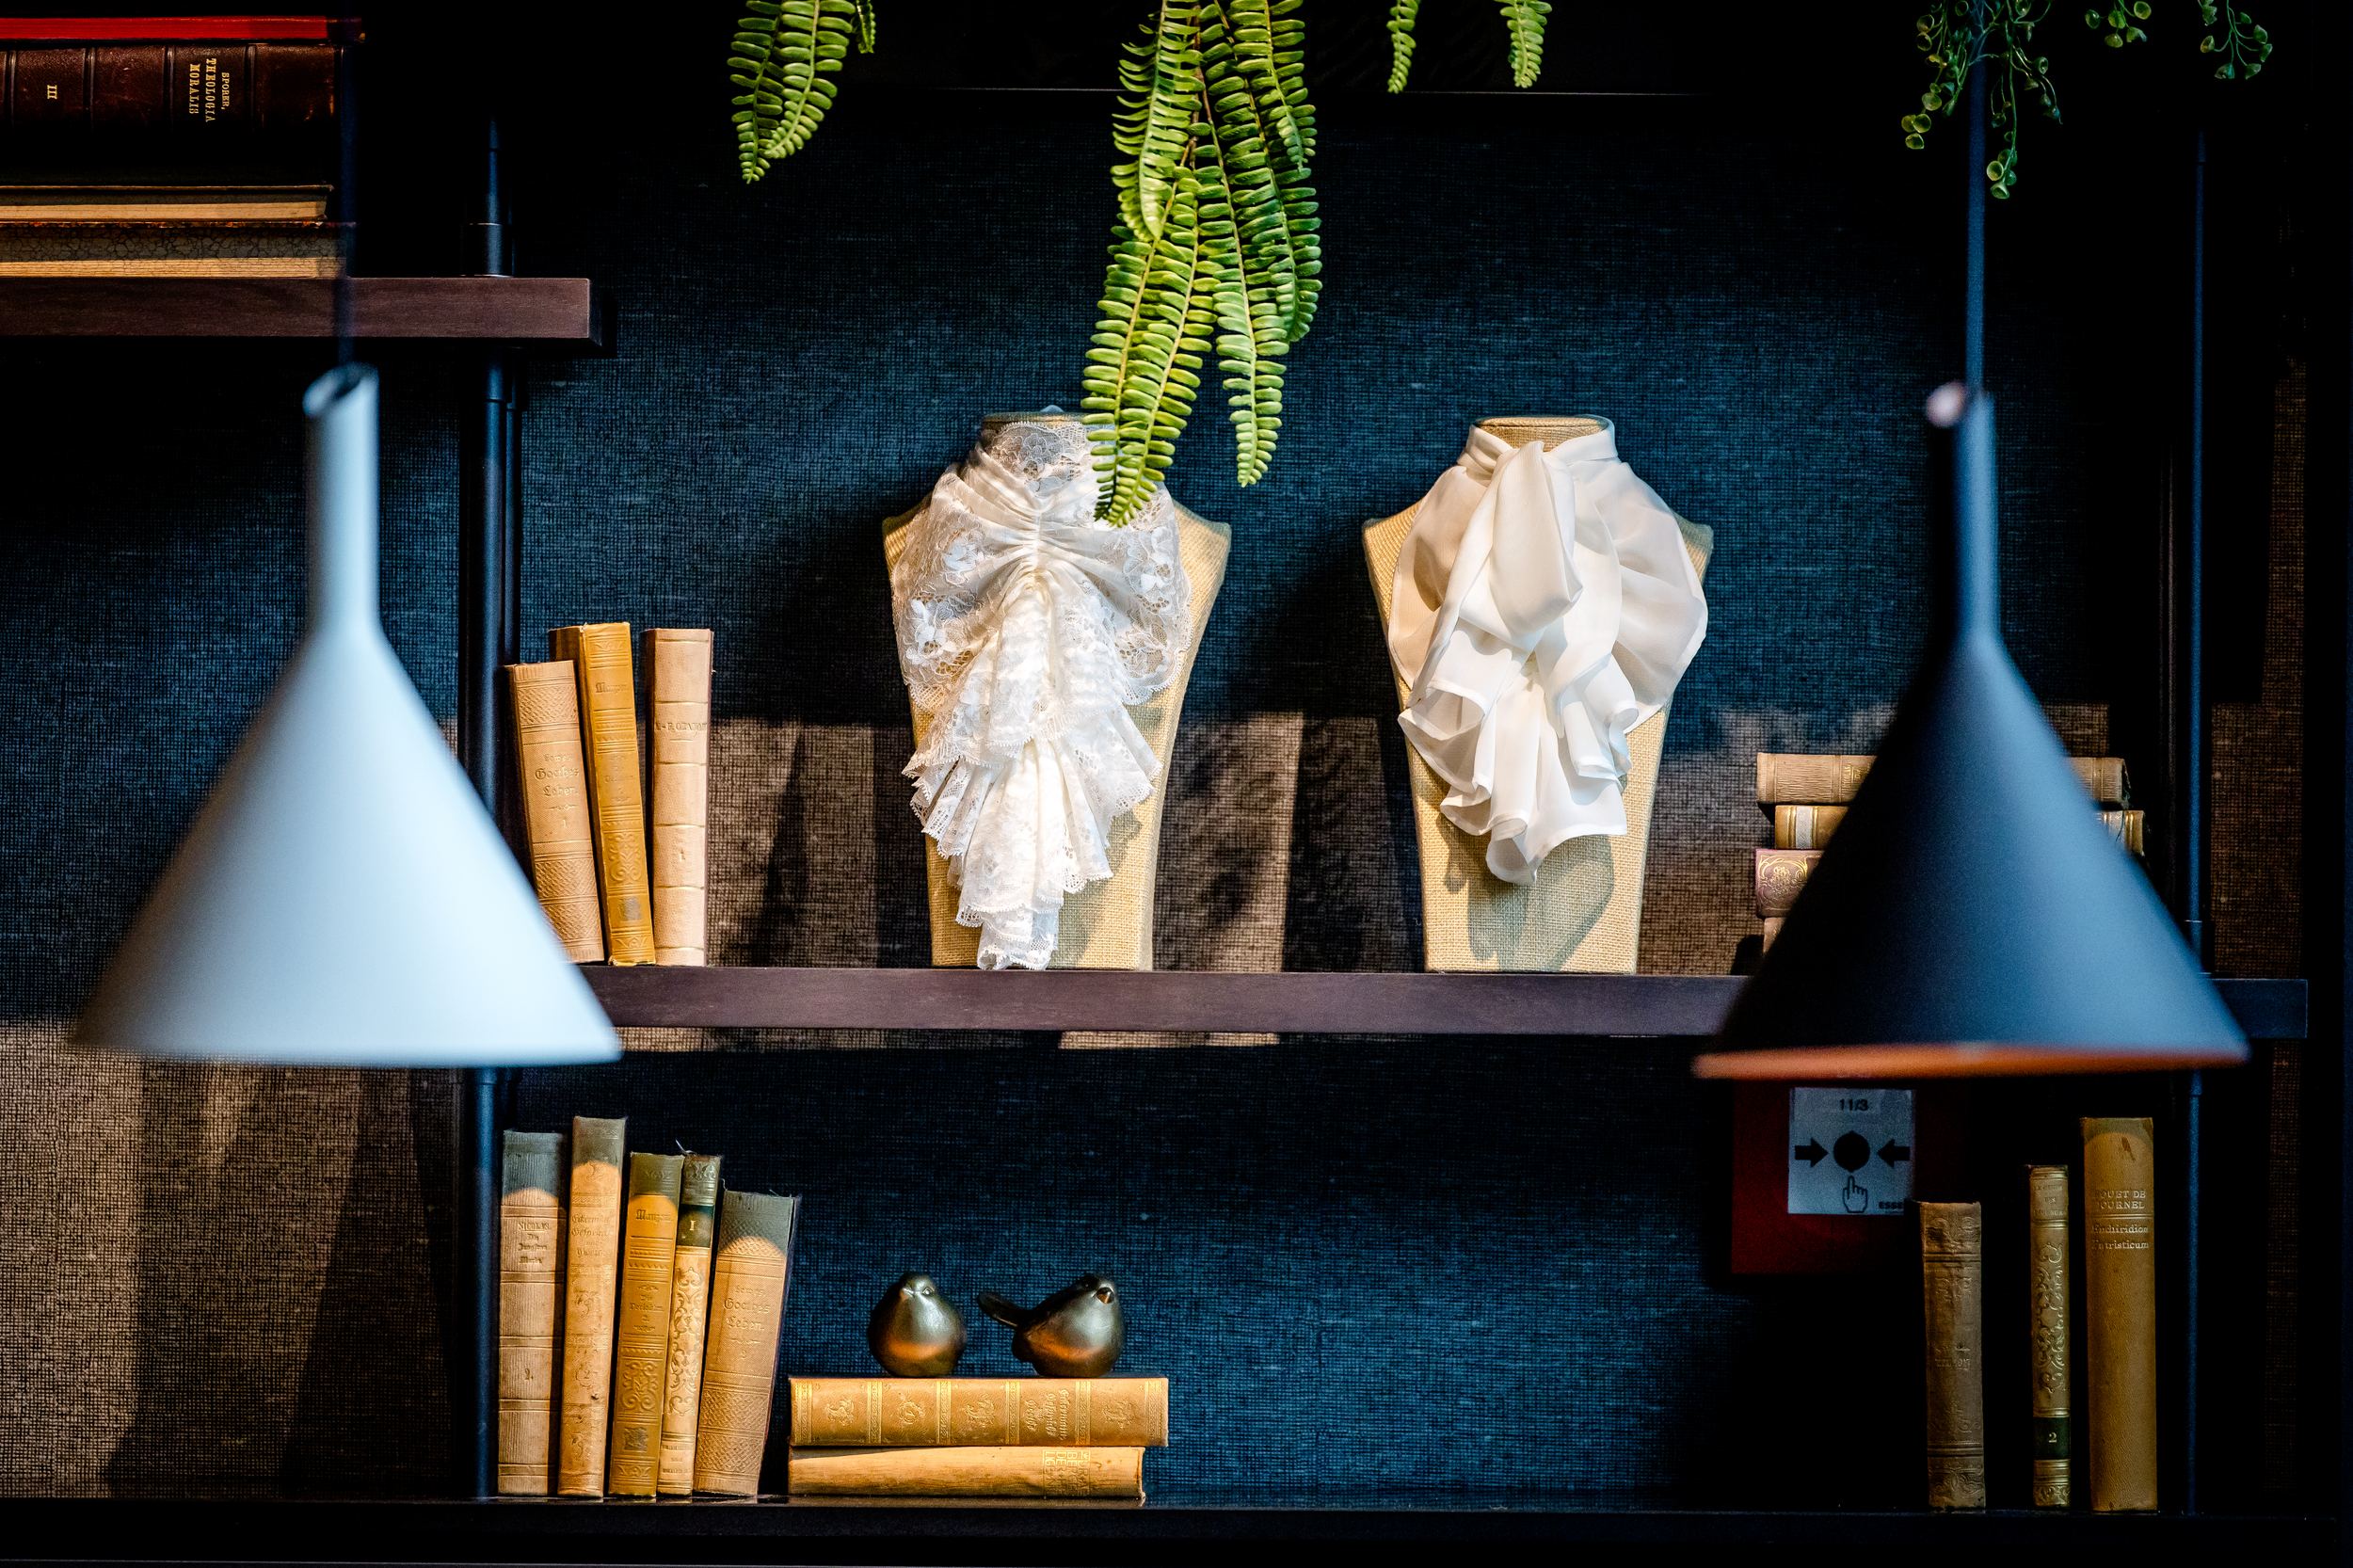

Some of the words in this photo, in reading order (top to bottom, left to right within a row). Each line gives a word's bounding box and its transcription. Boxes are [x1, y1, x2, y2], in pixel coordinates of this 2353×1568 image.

[188, 63, 200, 114] MORALIS
[205, 57, 217, 122] THEOLOGIA
[221, 72, 231, 110] SPORER,
[1840, 1098, 1868, 1112] 11/3
[2133, 1190, 2146, 1199] DE
[2048, 1432, 2057, 1443] 2
